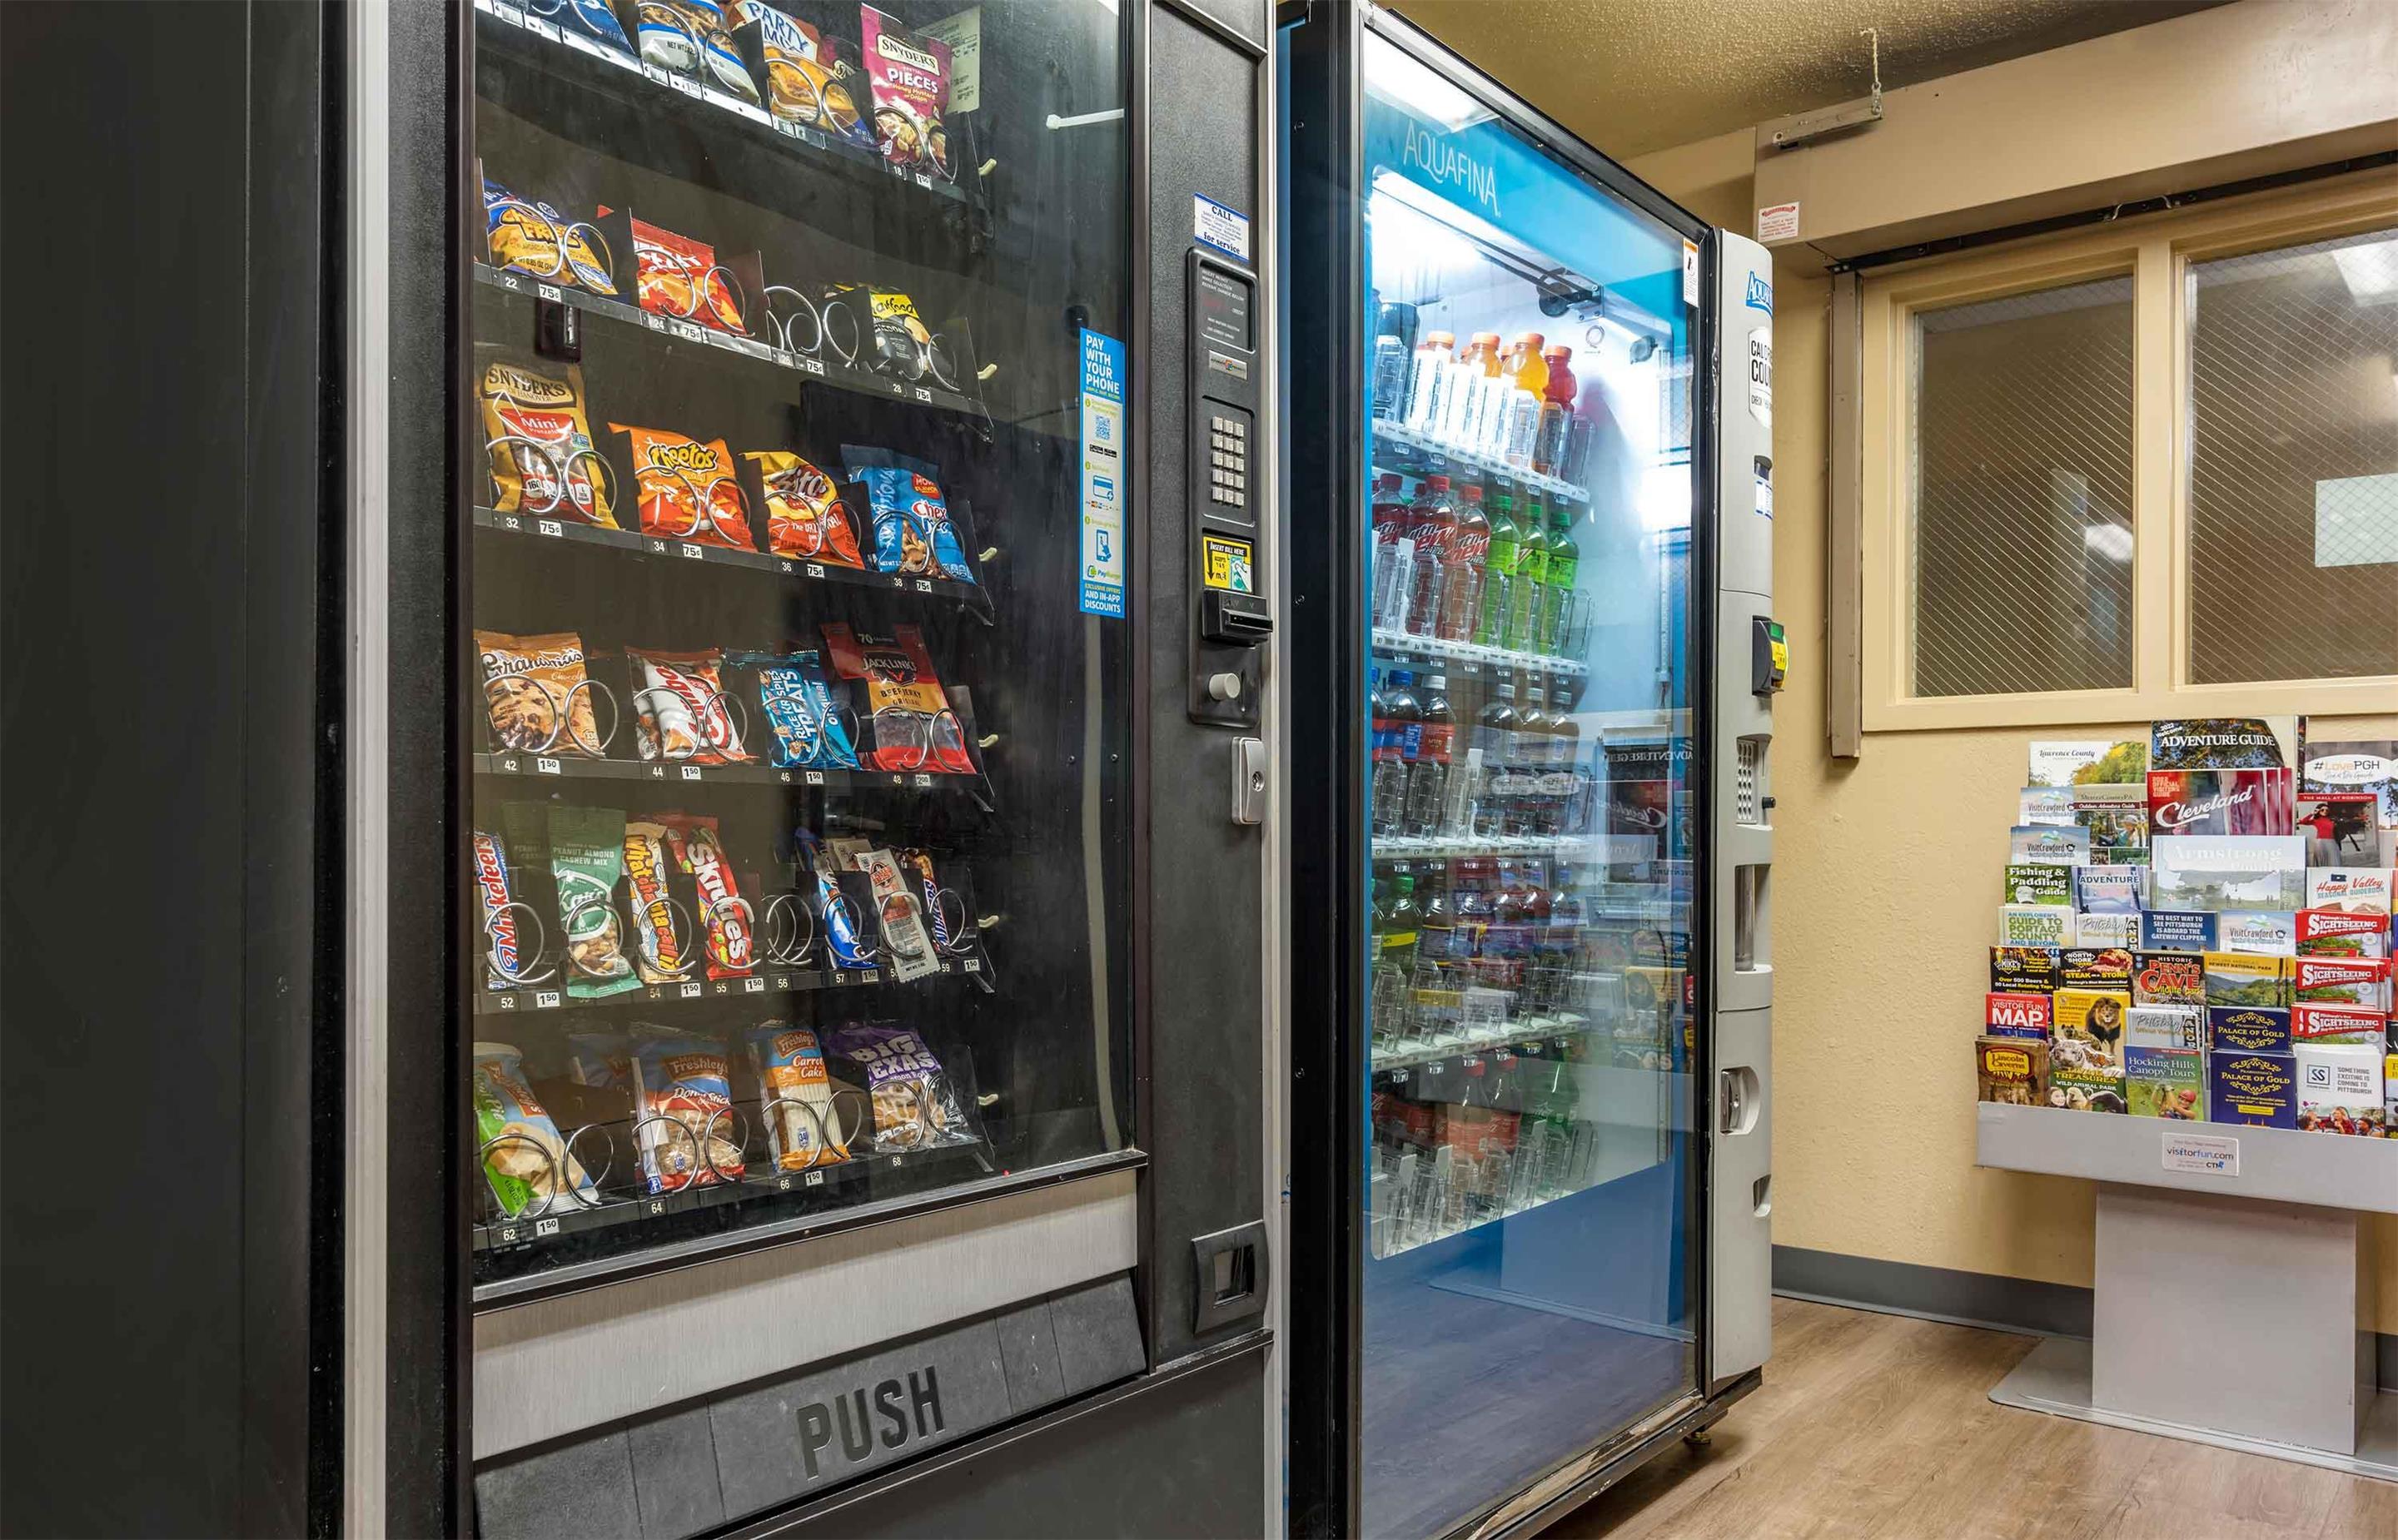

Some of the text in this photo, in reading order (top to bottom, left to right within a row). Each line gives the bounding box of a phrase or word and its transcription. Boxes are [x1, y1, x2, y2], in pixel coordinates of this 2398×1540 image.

[749, 2, 808, 52] PARTY
[764, 23, 801, 54] MIX
[887, 67, 938, 93] PIECES
[912, 88, 936, 100] Mustard
[893, 166, 903, 176] 18
[1403, 118, 1501, 218] AQUAFINA
[1211, 206, 1232, 222] CALL
[1203, 231, 1241, 255] for service
[505, 276, 518, 289] 22
[654, 320, 664, 330] 24
[1086, 334, 1105, 350] PAY
[1086, 347, 1112, 366] WITH
[1086, 360, 1112, 380] YOUR
[489, 367, 568, 397] SNYDER'S
[893, 383, 902, 393] 28
[1086, 373, 1120, 395] PHONE
[520, 416, 559, 429] Mini
[912, 499, 948, 519] Chex
[506, 517, 519, 529] 32
[654, 541, 665, 552] 34
[1210, 542, 1246, 556] INSERT BILL HERE
[781, 562, 792, 572] 36
[893, 578, 903, 588] 38
[1085, 589, 1121, 604] AND IN-APP
[1085, 599, 1121, 614] DISCOUNTS
[858, 633, 873, 644] 70
[863, 657, 888, 671] JACK
[880, 687, 903, 698] BEEF
[787, 715, 808, 739] RICE
[2161, 734, 2276, 748] ADVENTURE GUIDE
[2071, 750, 2096, 759] County
[505, 760, 517, 772] 42
[2314, 760, 2381, 771] #LovePGH
[652, 767, 664, 777] 44
[781, 772, 791, 782] 46
[893, 774, 903, 785] 48
[2156, 784, 2253, 827] Cleveland
[553, 847, 614, 858] PEANUT ALMOND
[2027, 842, 2065, 853] VisitCrawford
[560, 855, 609, 867] CASHEW MIX
[2009, 867, 2066, 879] Fishing &
[2010, 877, 2067, 889] Paddling
[2079, 876, 2140, 884] ADVENTURE
[2316, 877, 2384, 893] Happy Valley
[2036, 887, 2067, 896] Guide
[2047, 917, 2063, 926] TO
[2308, 913, 2378, 936] SIGHTSEEING
[2008, 925, 2063, 933] PORTAGE
[2229, 927, 2274, 939] VisitCrawford
[941, 962, 950, 973] 59
[2148, 960, 2201, 975] PENN'S
[835, 973, 845, 984] 57
[2301, 964, 2373, 986] SIGHTSEEING
[778, 978, 788, 989] 56
[2139, 969, 2201, 994] CAVE
[649, 989, 661, 999] 54
[716, 983, 728, 994] 55
[501, 997, 514, 1009] 52
[1993, 1001, 2025, 1010] VISITOR
[1992, 1008, 2045, 1027] MAP
[2308, 1011, 2380, 1034] SIGHTSEEING
[2218, 1026, 2247, 1036] PALACE
[2261, 1028, 2286, 1039] GOLD
[848, 1034, 915, 1063] BIG
[792, 1055, 825, 1067] Carrot
[1992, 1053, 2026, 1064] Lincoln
[2128, 1056, 2196, 1070] Hocking Hills
[670, 1057, 729, 1075] Freshley's
[873, 1051, 936, 1080] EXAS
[1992, 1061, 2026, 1070] Caverns
[2128, 1066, 2197, 1077] Canopy Tours
[2336, 1066, 2371, 1075] SOMETHING
[800, 1066, 823, 1079] Cake
[2054, 1071, 2118, 1084] TREASURES
[2221, 1071, 2252, 1081] PALACE
[2266, 1075, 2291, 1085] GOLD
[2336, 1073, 2363, 1081] EXCITING
[2336, 1080, 2360, 1088] COMING
[2336, 1086, 2372, 1095] PITTSBURGH
[2167, 1146, 2235, 1161] visitorfun.com
[892, 1156, 902, 1167] 68
[780, 1179, 790, 1190] 66
[651, 1203, 663, 1214] 64
[503, 1228, 516, 1240] 62
[796, 1364, 946, 1481] PUSH
